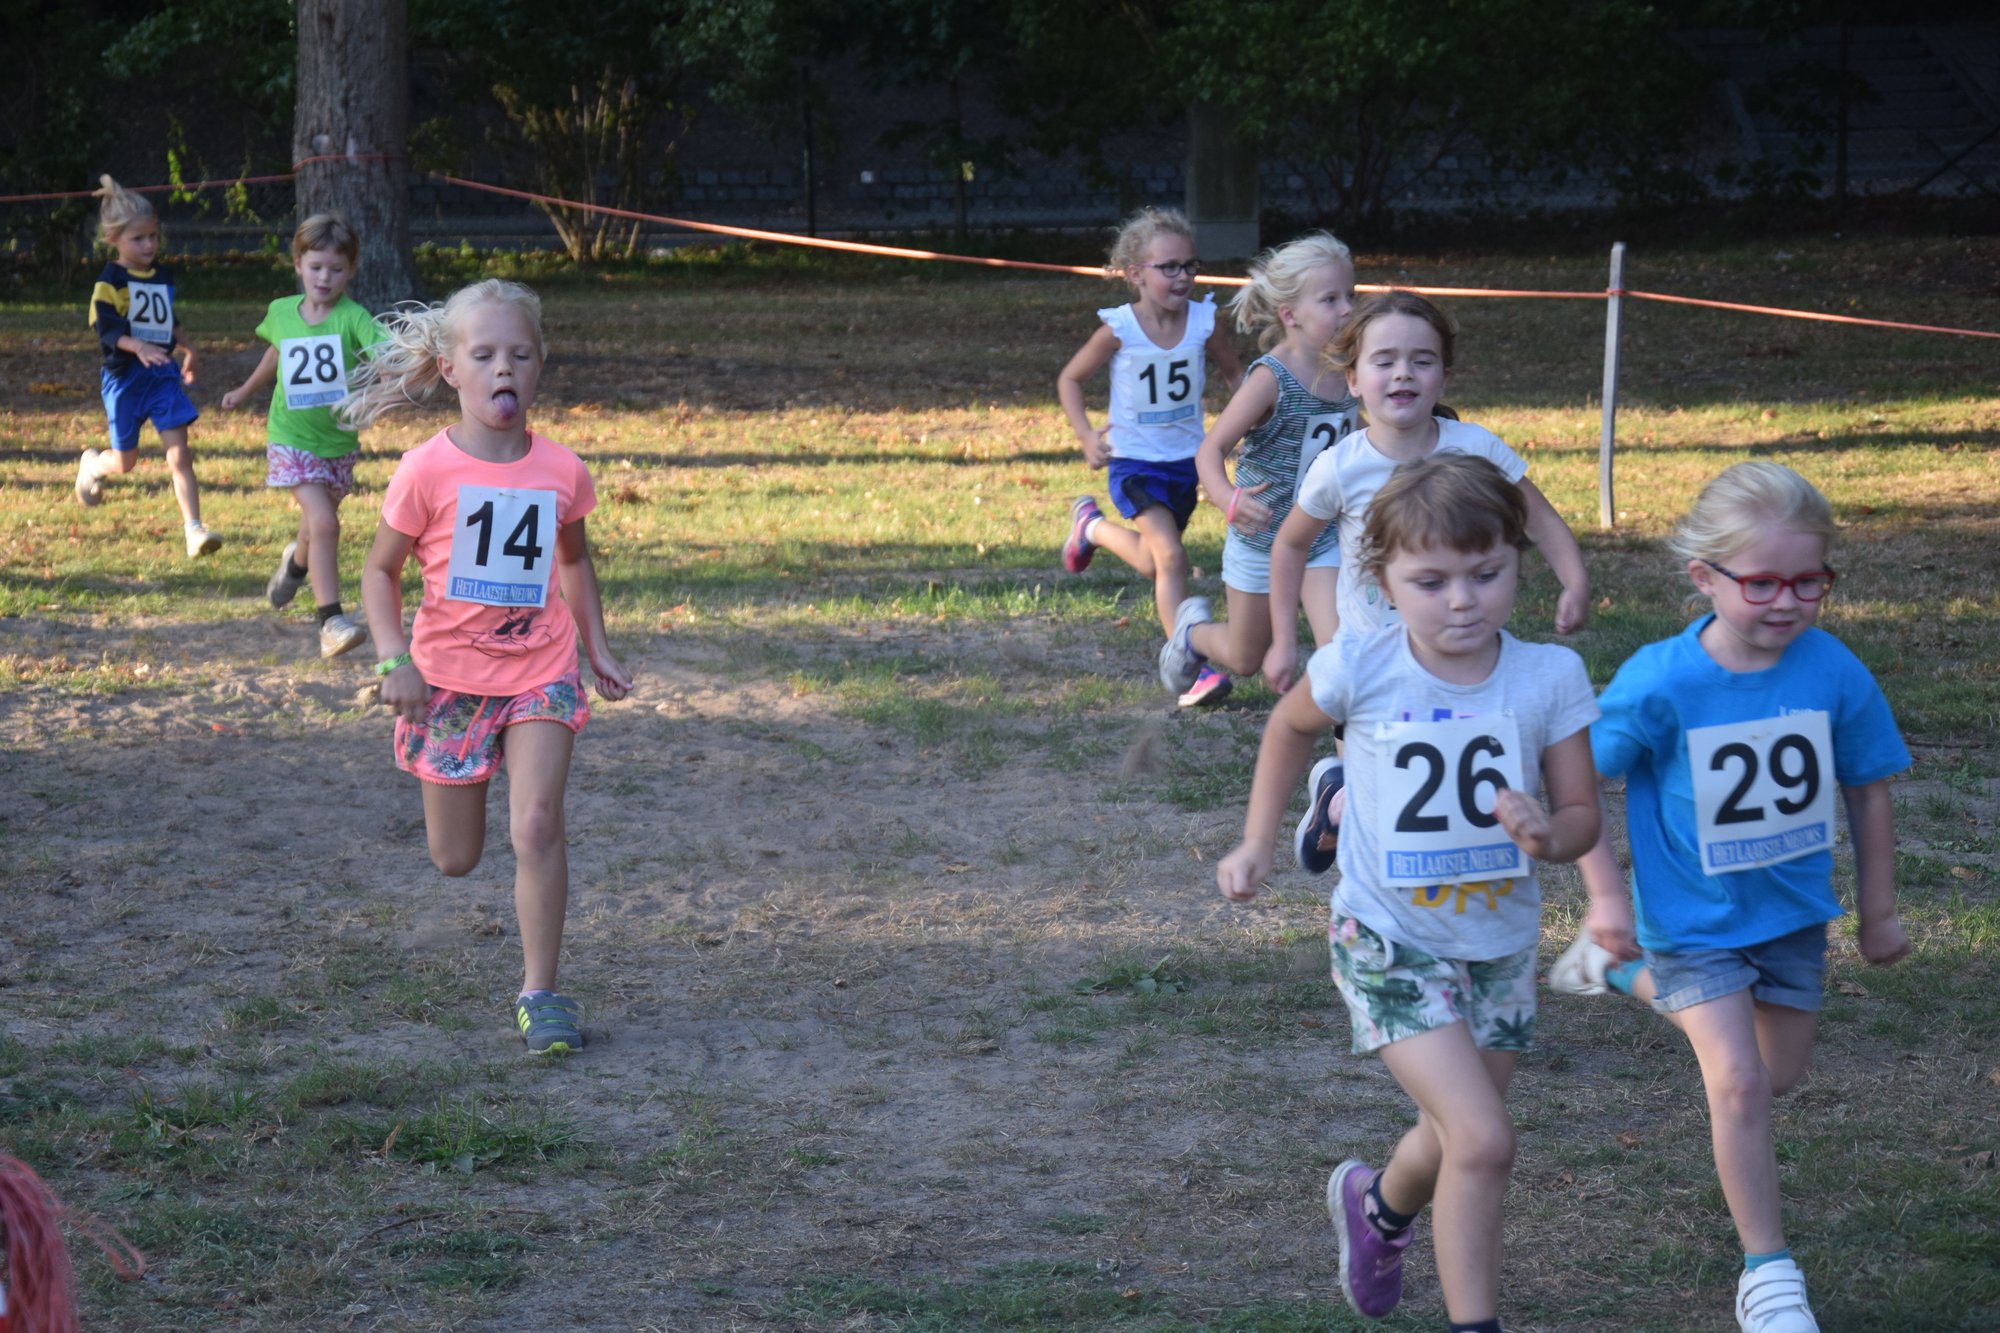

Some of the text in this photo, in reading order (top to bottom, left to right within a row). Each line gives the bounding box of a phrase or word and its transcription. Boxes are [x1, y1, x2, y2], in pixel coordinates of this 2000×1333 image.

[132, 290, 168, 324] 20
[288, 343, 338, 385] 28
[1139, 359, 1191, 404] 15
[466, 501, 543, 571] 14
[1394, 734, 1511, 833] 26
[1710, 733, 1820, 825] 29
